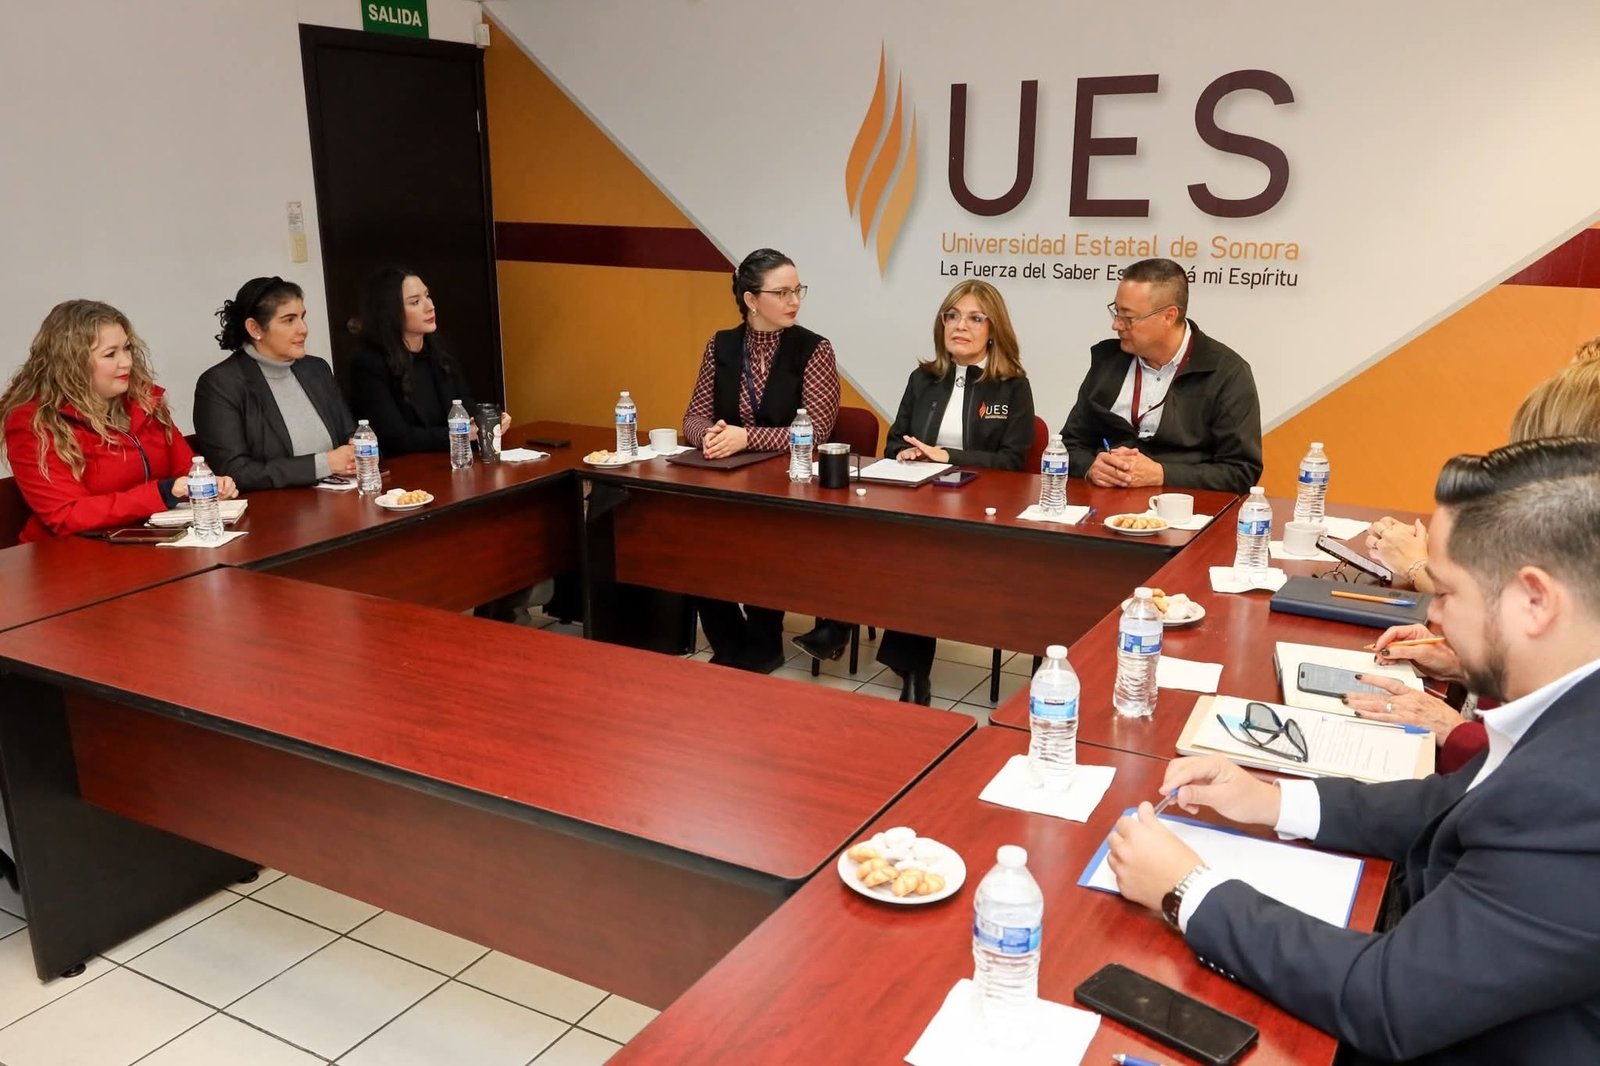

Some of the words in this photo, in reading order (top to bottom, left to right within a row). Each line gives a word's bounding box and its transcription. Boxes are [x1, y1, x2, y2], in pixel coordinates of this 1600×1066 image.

[368, 3, 422, 27] SALIDA
[948, 69, 1295, 218] UES
[941, 232, 1066, 256] Universidad
[1075, 233, 1158, 258] Estatal
[1170, 235, 1198, 259] de
[1210, 235, 1299, 261] Sonora
[940, 260, 959, 276] La
[964, 261, 1017, 278] Fuerza
[1023, 262, 1046, 279] del
[1052, 263, 1101, 281] Saber
[1203, 267, 1222, 285] mi
[1229, 266, 1298, 290] Espíritu
[985, 404, 1009, 415] UES
